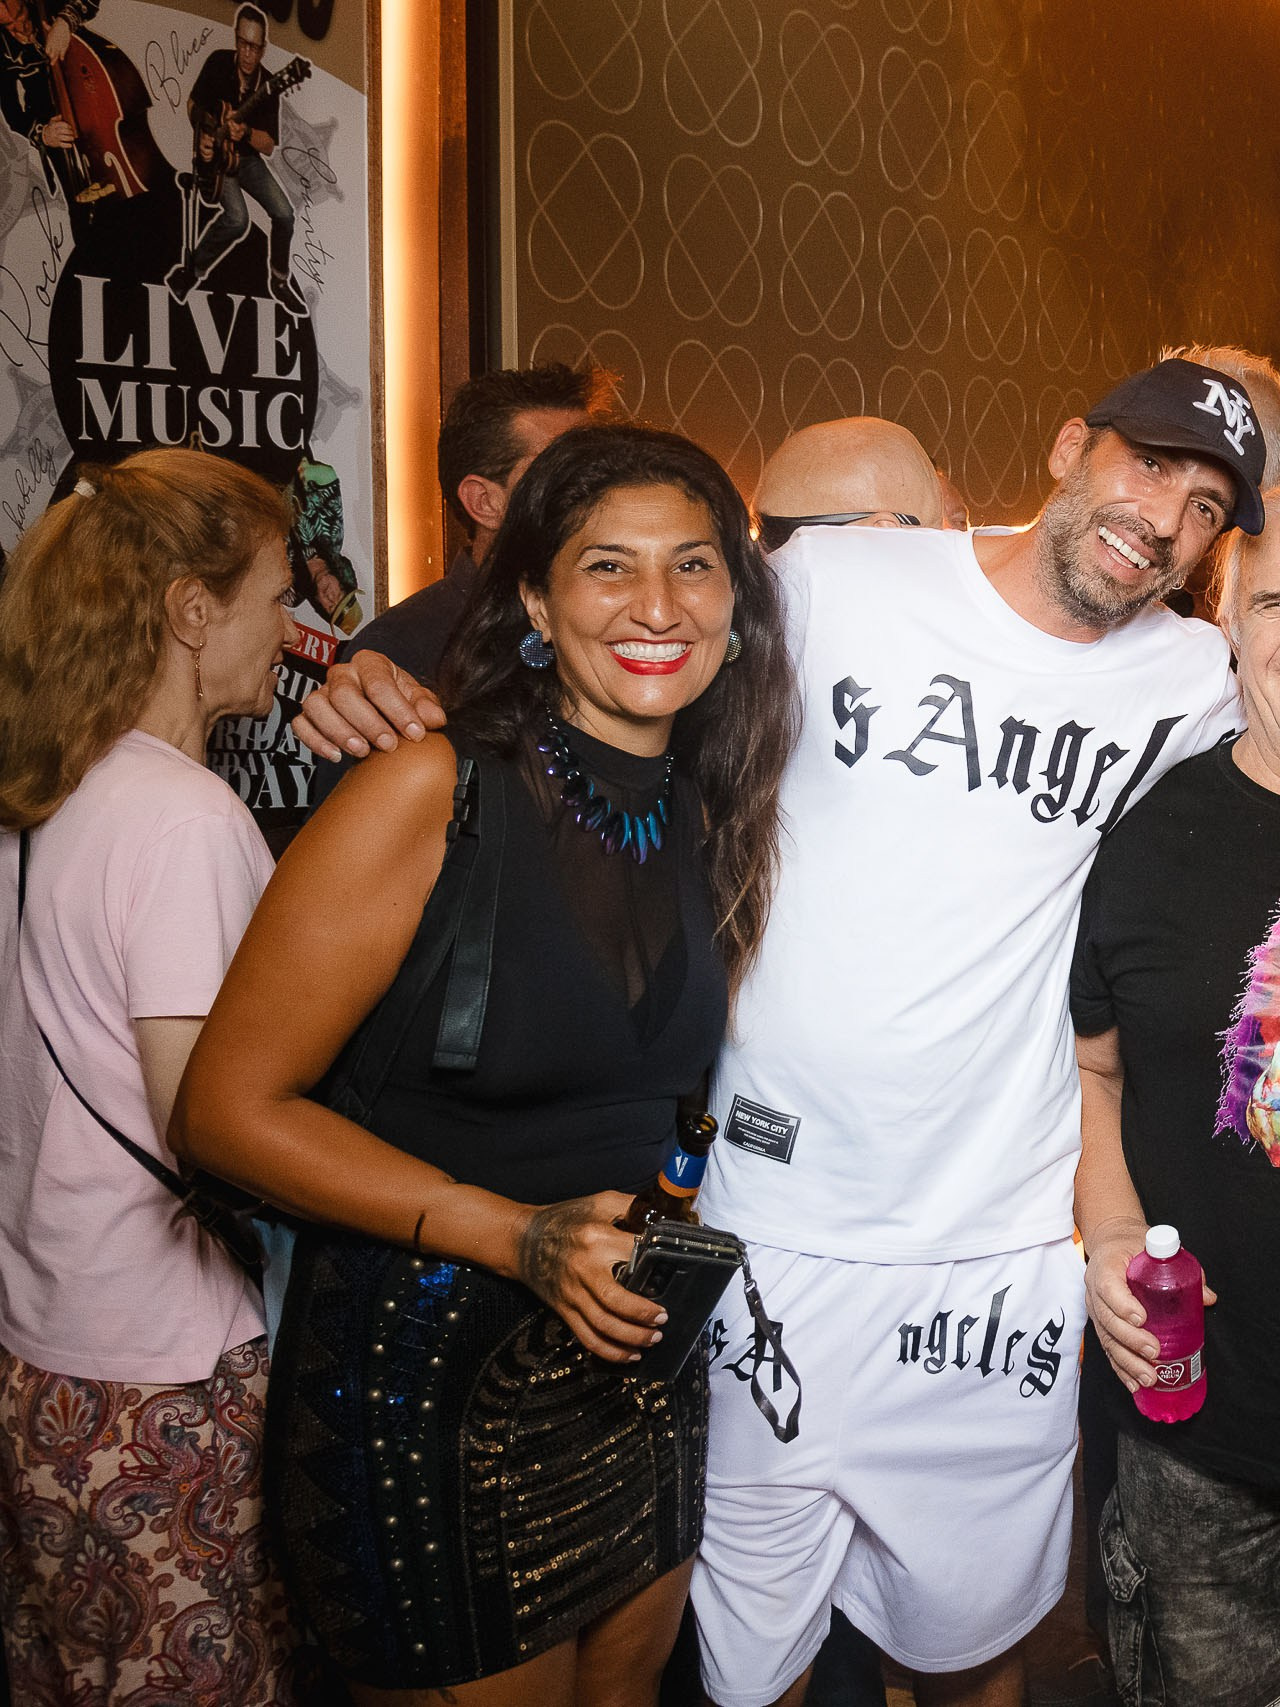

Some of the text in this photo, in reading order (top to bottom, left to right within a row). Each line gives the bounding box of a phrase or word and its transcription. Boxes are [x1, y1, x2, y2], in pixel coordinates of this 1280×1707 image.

[145, 27, 213, 114] Blues
[74, 274, 302, 382] LIVE
[77, 377, 305, 450] MUSIC
[293, 628, 336, 665] ERY
[883, 673, 1189, 835] Angel
[735, 1110, 788, 1134] NEW YORK CITY
